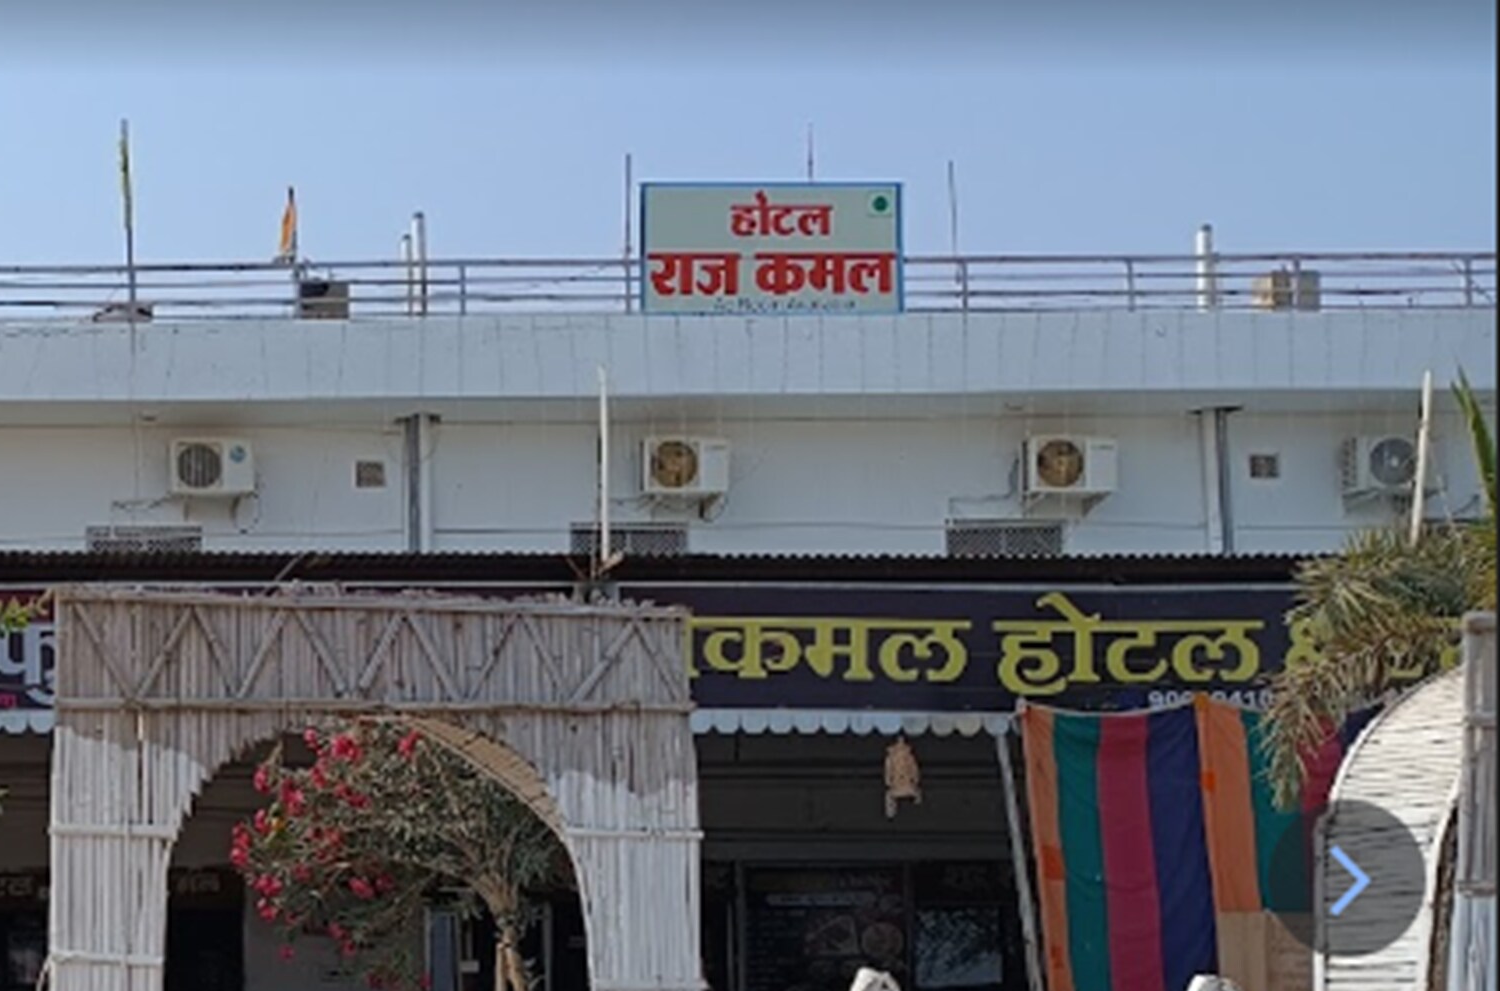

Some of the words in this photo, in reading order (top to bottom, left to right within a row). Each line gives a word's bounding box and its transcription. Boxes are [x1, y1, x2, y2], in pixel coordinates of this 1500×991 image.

[730, 190, 833, 236] होटल
[647, 252, 741, 296] राज
[754, 252, 896, 295] कमल
[689, 616, 972, 681] कमल
[992, 592, 1265, 696] होटल
